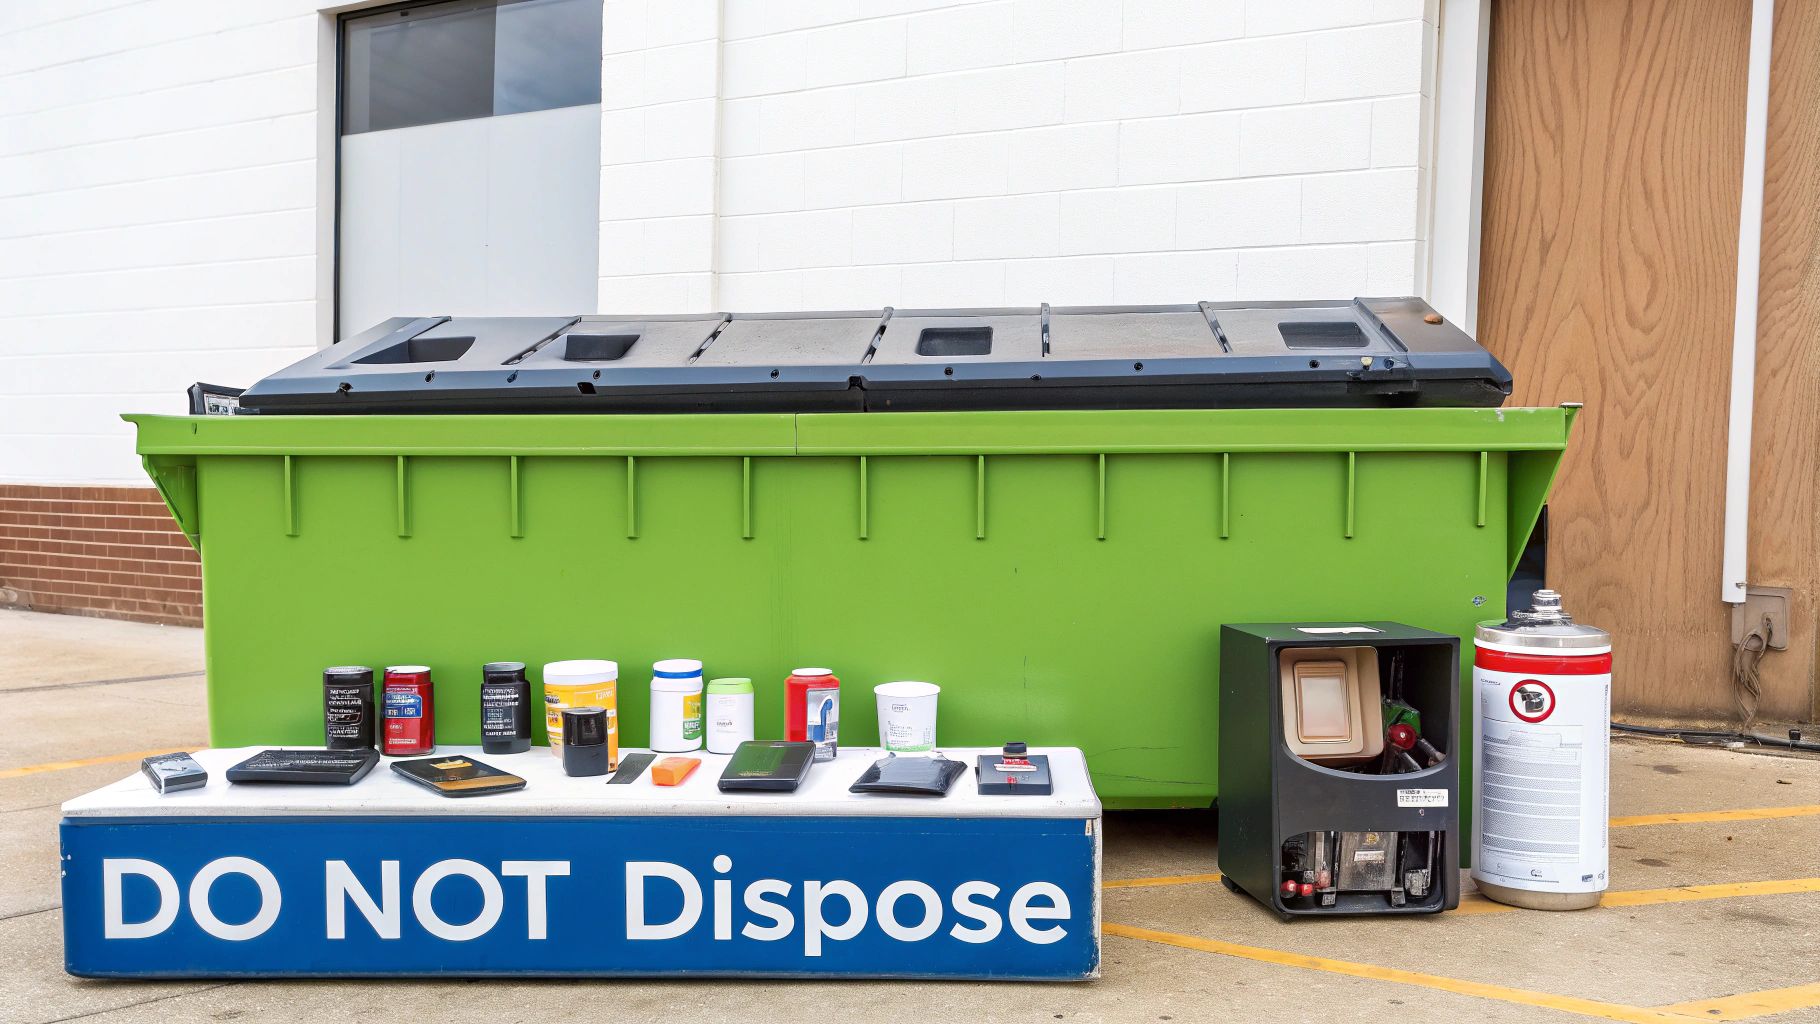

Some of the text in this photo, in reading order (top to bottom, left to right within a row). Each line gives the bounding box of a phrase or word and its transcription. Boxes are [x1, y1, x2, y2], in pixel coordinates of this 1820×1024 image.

[103, 855, 1071, 957] DO NOT Dispose
